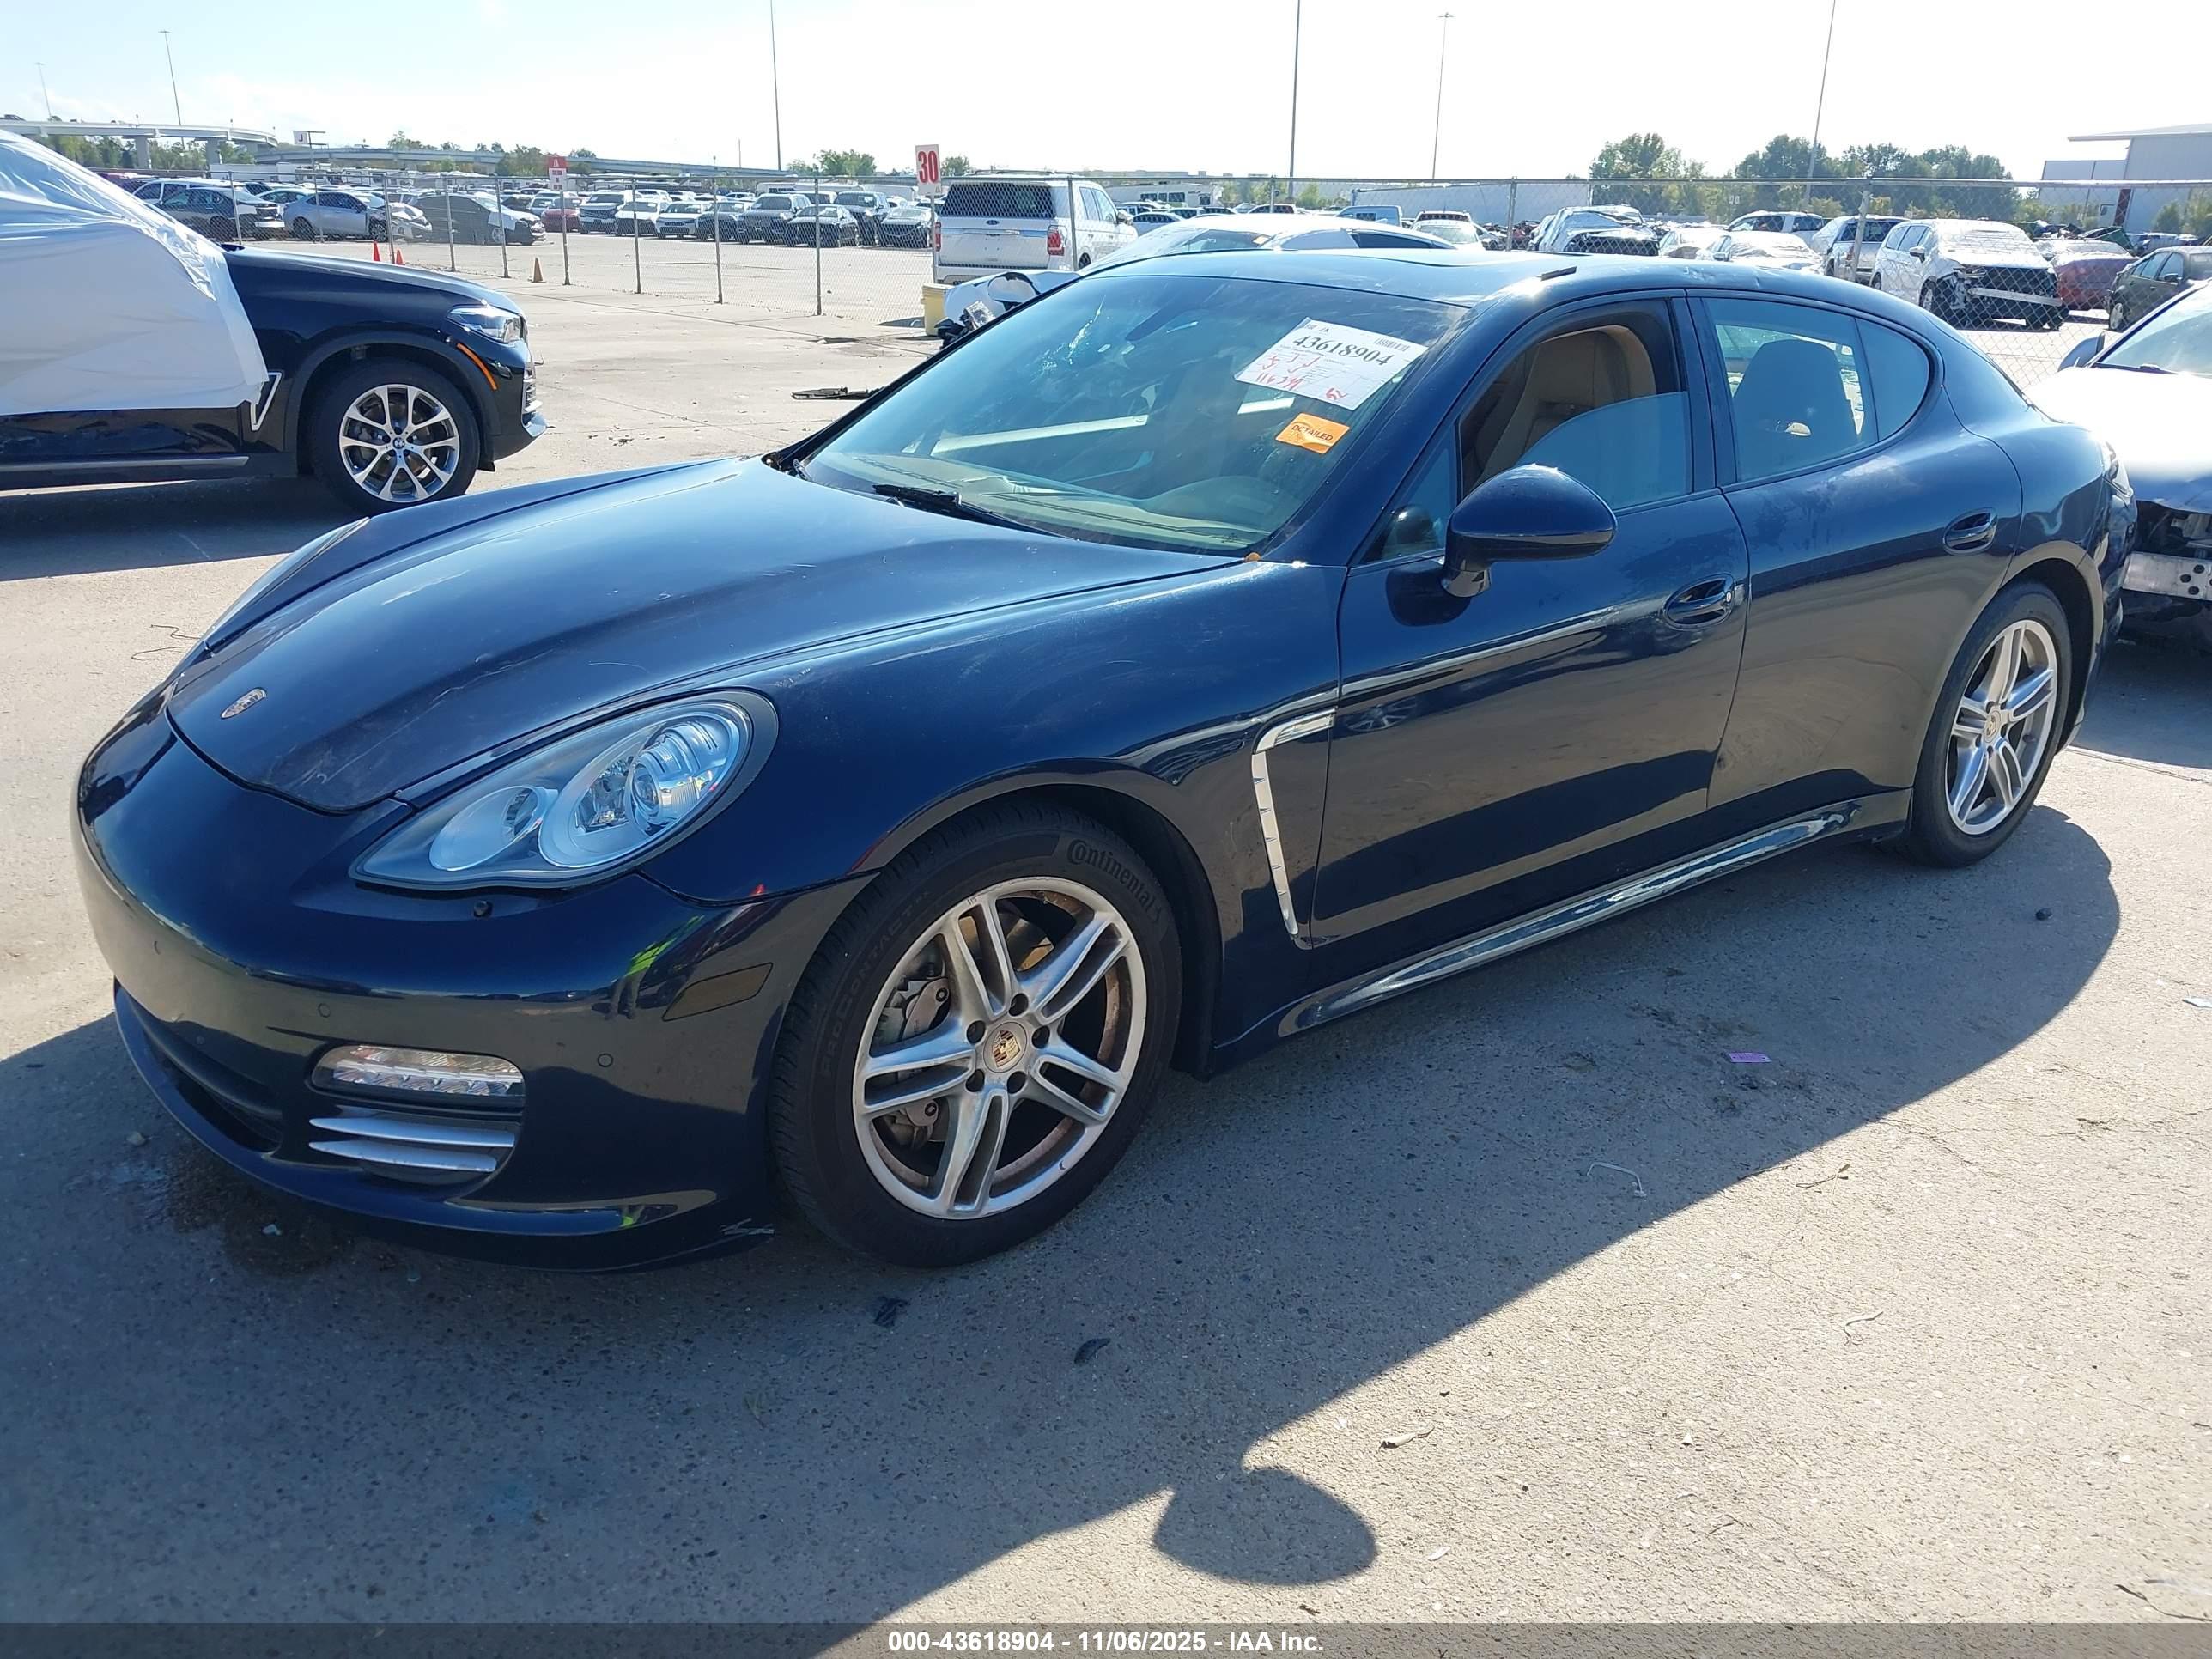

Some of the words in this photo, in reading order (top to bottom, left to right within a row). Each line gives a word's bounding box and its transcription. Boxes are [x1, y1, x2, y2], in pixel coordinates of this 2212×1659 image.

[918, 151, 939, 183] 30
[1293, 335, 1395, 366] 43618904
[1292, 424, 1334, 441] DETAILED
[1067, 839, 1157, 912] Continental
